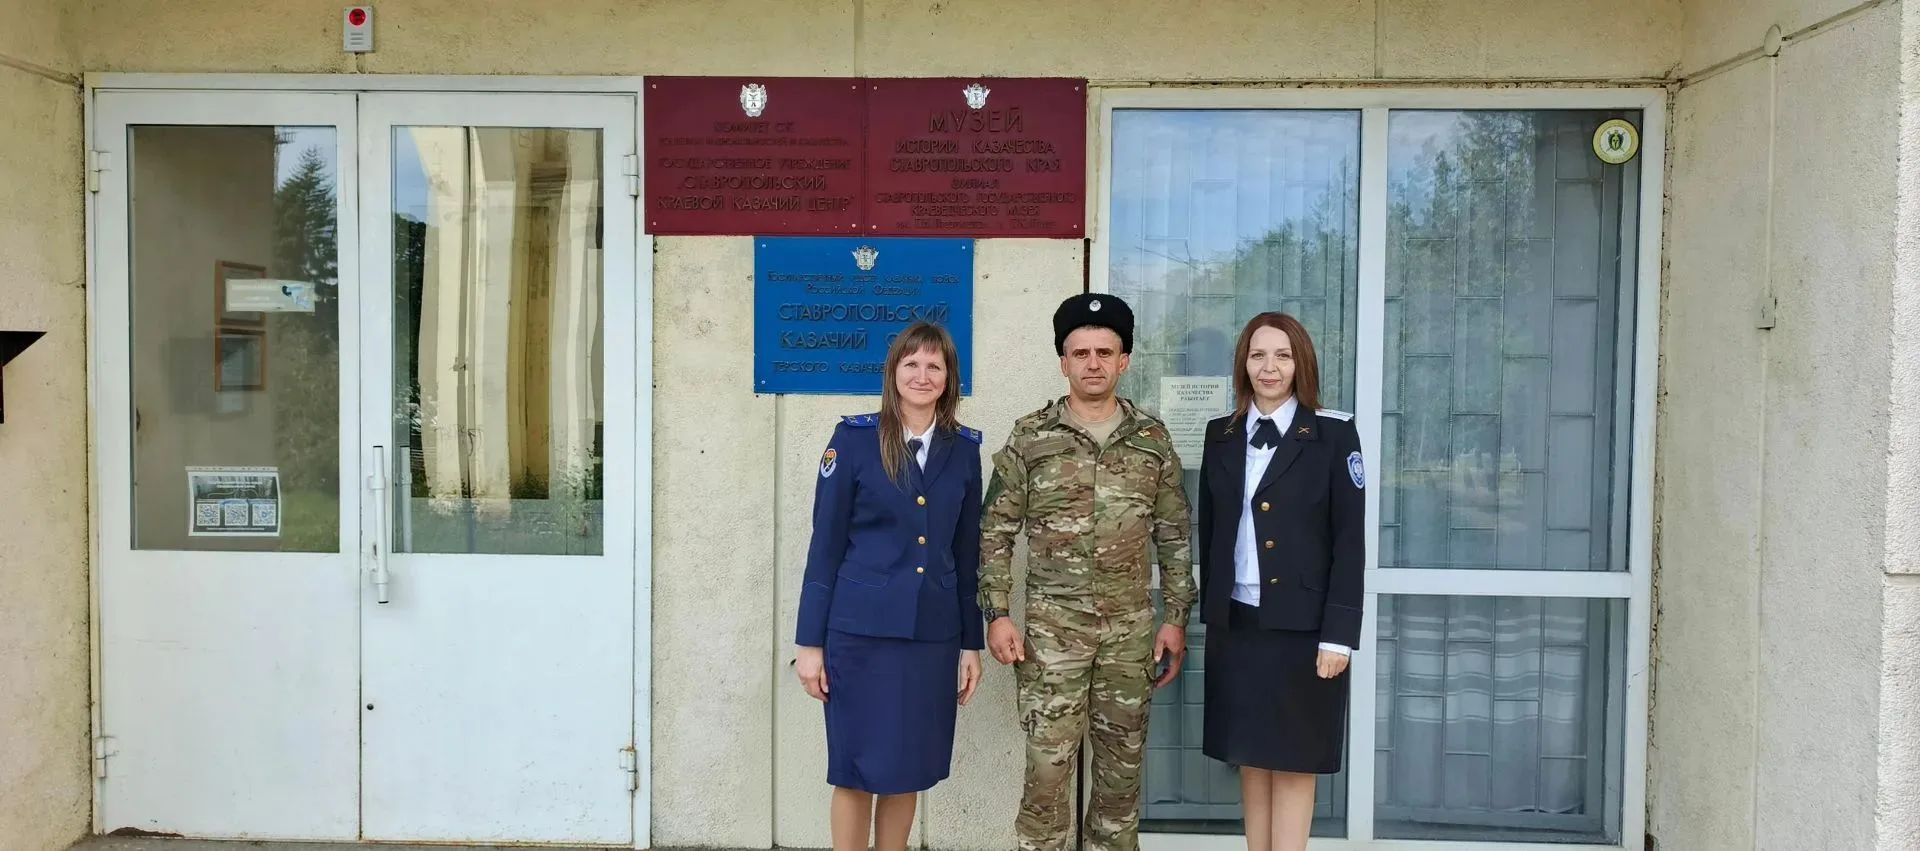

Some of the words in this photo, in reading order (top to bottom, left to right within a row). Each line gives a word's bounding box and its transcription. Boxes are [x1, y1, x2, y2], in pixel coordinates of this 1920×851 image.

[929, 107, 1023, 133] МУЗЕЙ
[896, 140, 959, 154] ИСТОРИИ
[971, 140, 1055, 154] КАЗАЧЕСТВА
[658, 158, 772, 170] ГОСУДАРСТВЕННОЕ
[779, 158, 852, 170] УЧРЕЖДЕНИЕ
[889, 159, 1014, 173] СТАВРОПОЛЬСКОГО
[1025, 159, 1061, 173] КРАЯ
[951, 178, 999, 190] ФИЛИАЛ
[657, 195, 723, 211] КРАЕВОЙ
[732, 194, 800, 211] КАЗАЧИЙ
[876, 192, 968, 204] СТАВРОПОЛЬСКОГО
[976, 192, 1076, 204] ГОСУДАРСТВЕННОГО
[911, 205, 998, 217] КРАЕВЕДЧЕСКОГО
[1008, 205, 1040, 217] МУЗЕЯ
[778, 301, 949, 322] СТАВРОПОЛЬСКИЙ
[780, 327, 868, 350] КАЗАЧИЙ
[773, 360, 829, 374] ТЕРСКОГО
